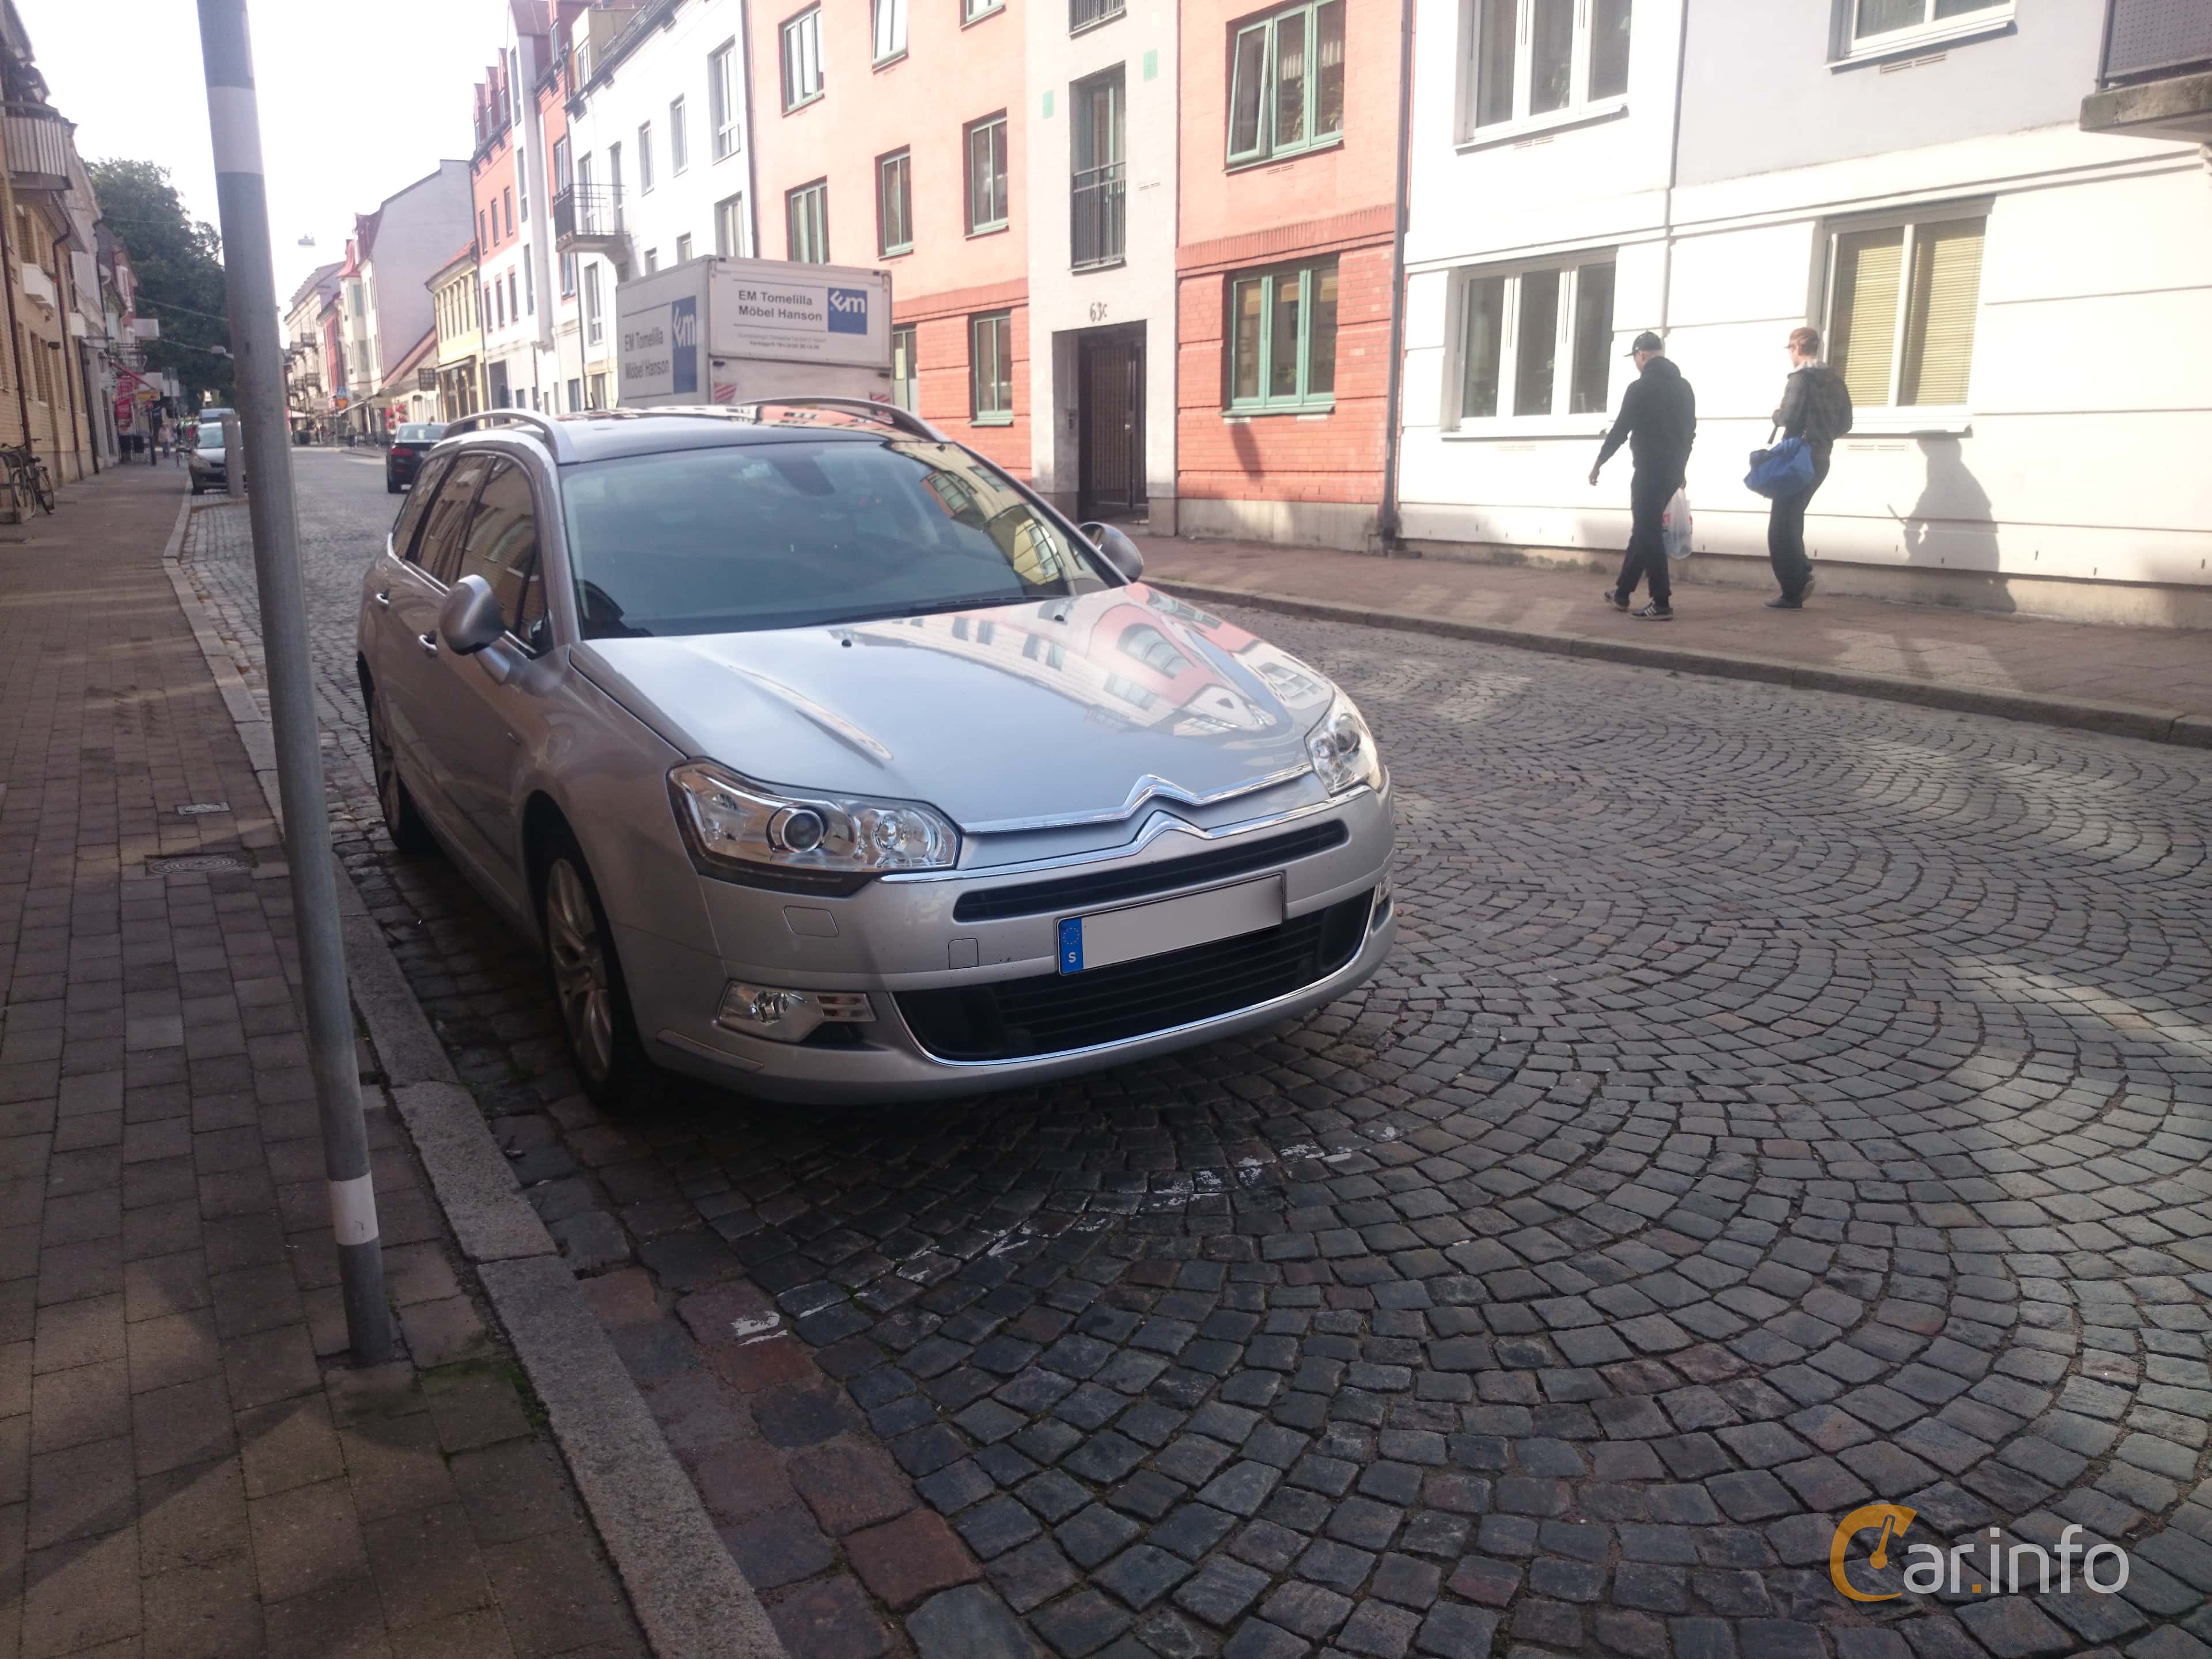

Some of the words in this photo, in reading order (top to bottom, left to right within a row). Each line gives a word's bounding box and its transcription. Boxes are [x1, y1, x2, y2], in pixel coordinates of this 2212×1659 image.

[739, 290, 756, 301] EM
[760, 292, 813, 306] Tomelilla
[738, 305, 774, 317] Möbel
[778, 309, 823, 321] Hanson
[625, 333, 634, 352] EM
[636, 327, 664, 349] Tomelilla
[625, 359, 644, 380] Möbel
[645, 359, 669, 377] Hanson
[1069, 952, 1076, 963] S
